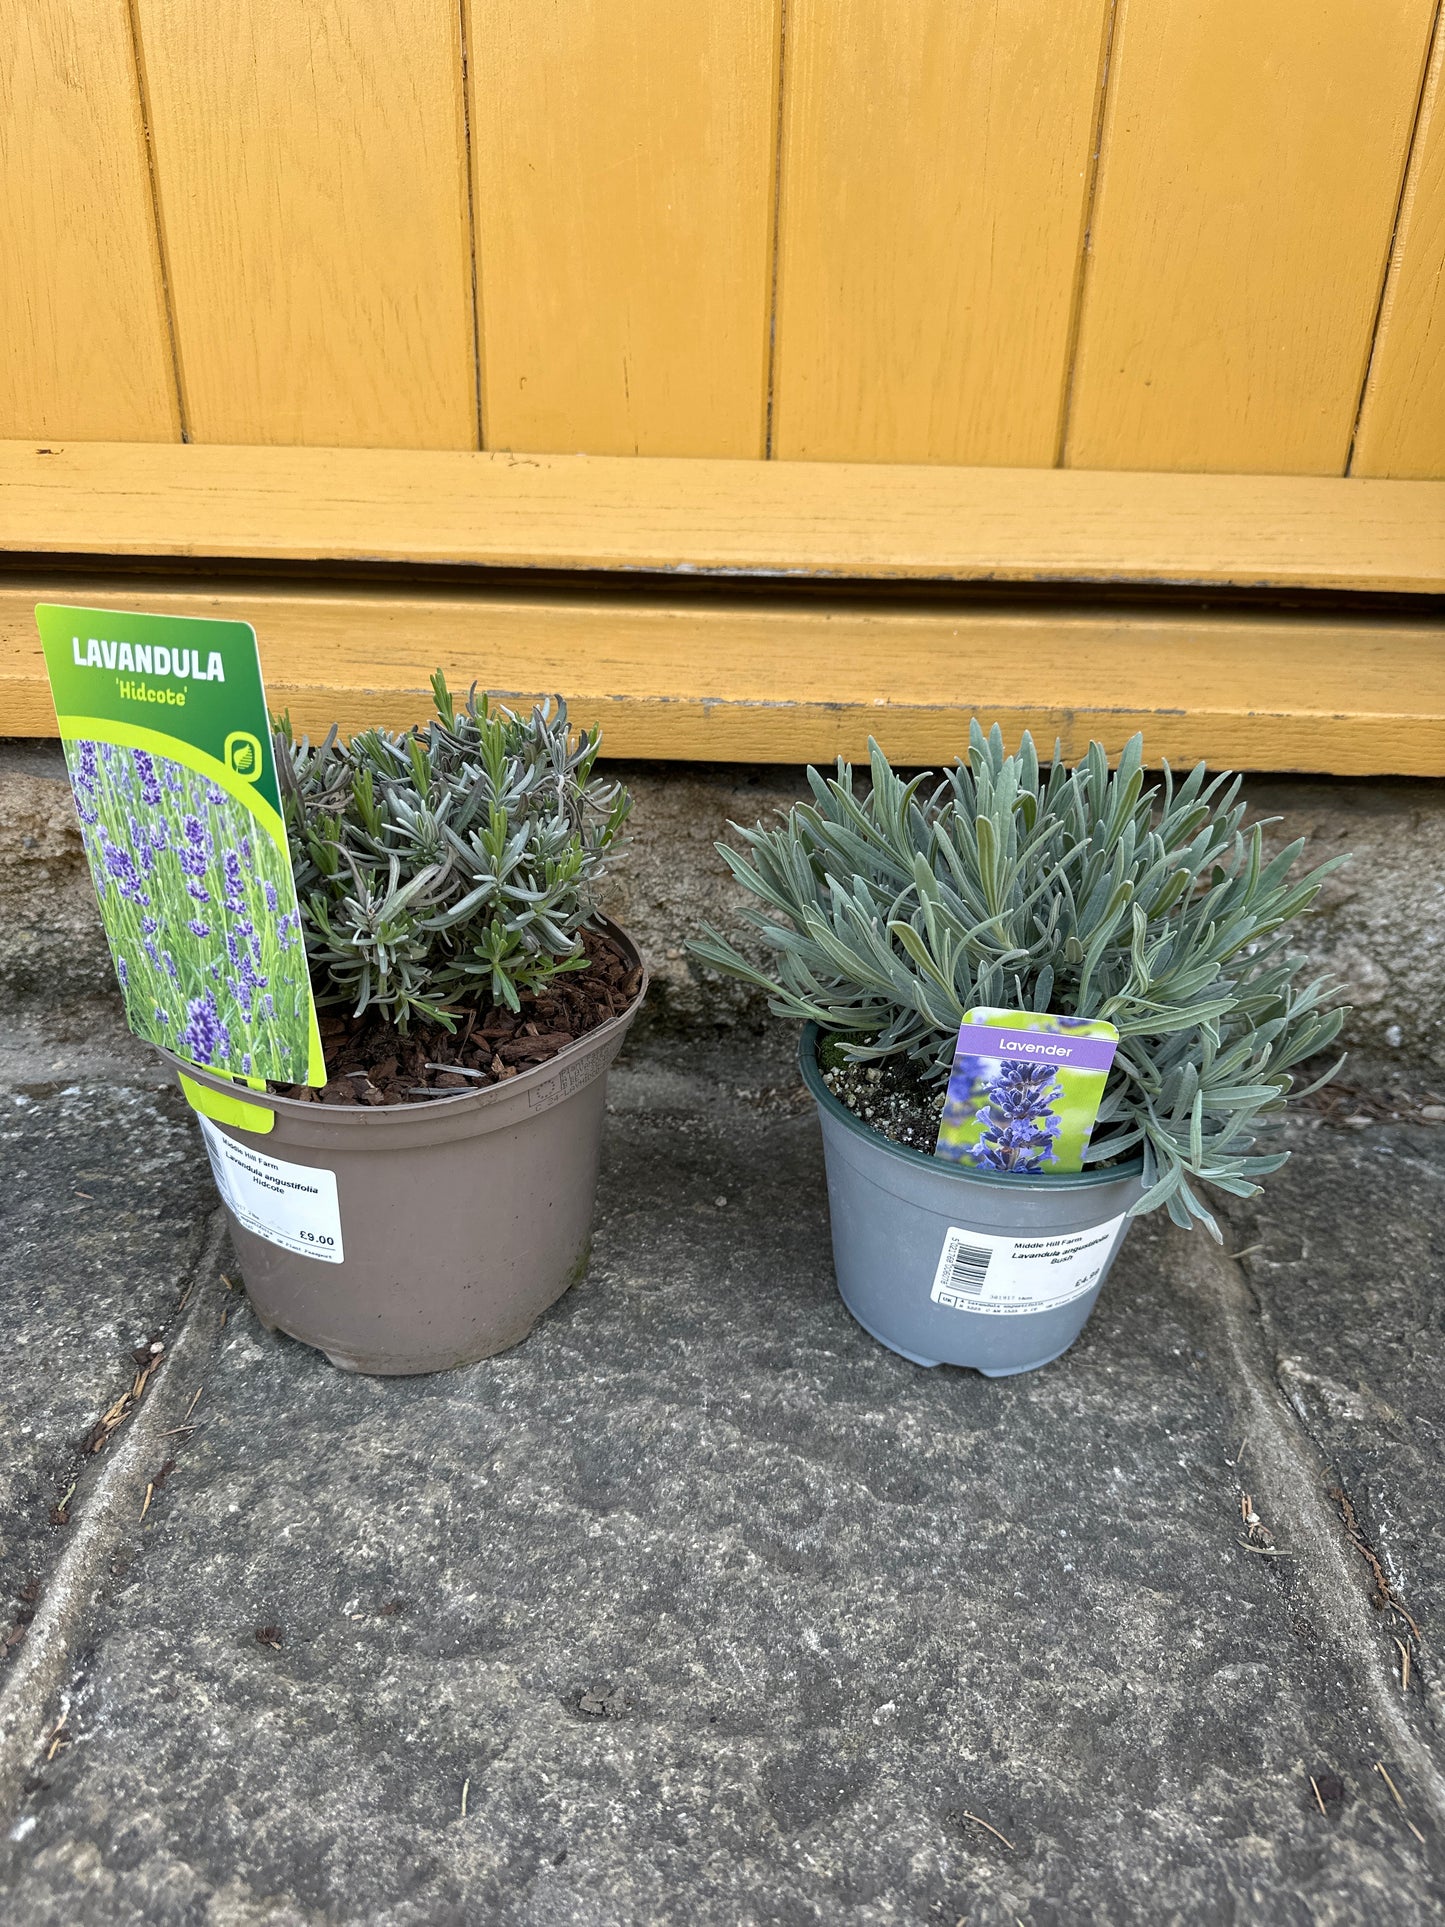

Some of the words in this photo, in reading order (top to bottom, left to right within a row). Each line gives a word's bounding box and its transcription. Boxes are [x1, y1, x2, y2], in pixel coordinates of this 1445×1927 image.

[72, 637, 225, 682] LAVANDULA
[115, 677, 188, 706] 'Hidcote'
[999, 1038, 1073, 1058] Lavender
[222, 1137, 243, 1155] Middle
[244, 1151, 257, 1162] Hill
[258, 1157, 279, 1171] Farm
[225, 1151, 263, 1177] Lavandula
[264, 1174, 319, 1194] angustifolia
[253, 1176, 285, 1194] Hidcote
[299, 1230, 335, 1246] £9.00
[1046, 1240, 1060, 1248] Hill
[1061, 1236, 1083, 1245] Farm
[1011, 1250, 1060, 1259] Lavandula
[1050, 1254, 1074, 1265] Bush
